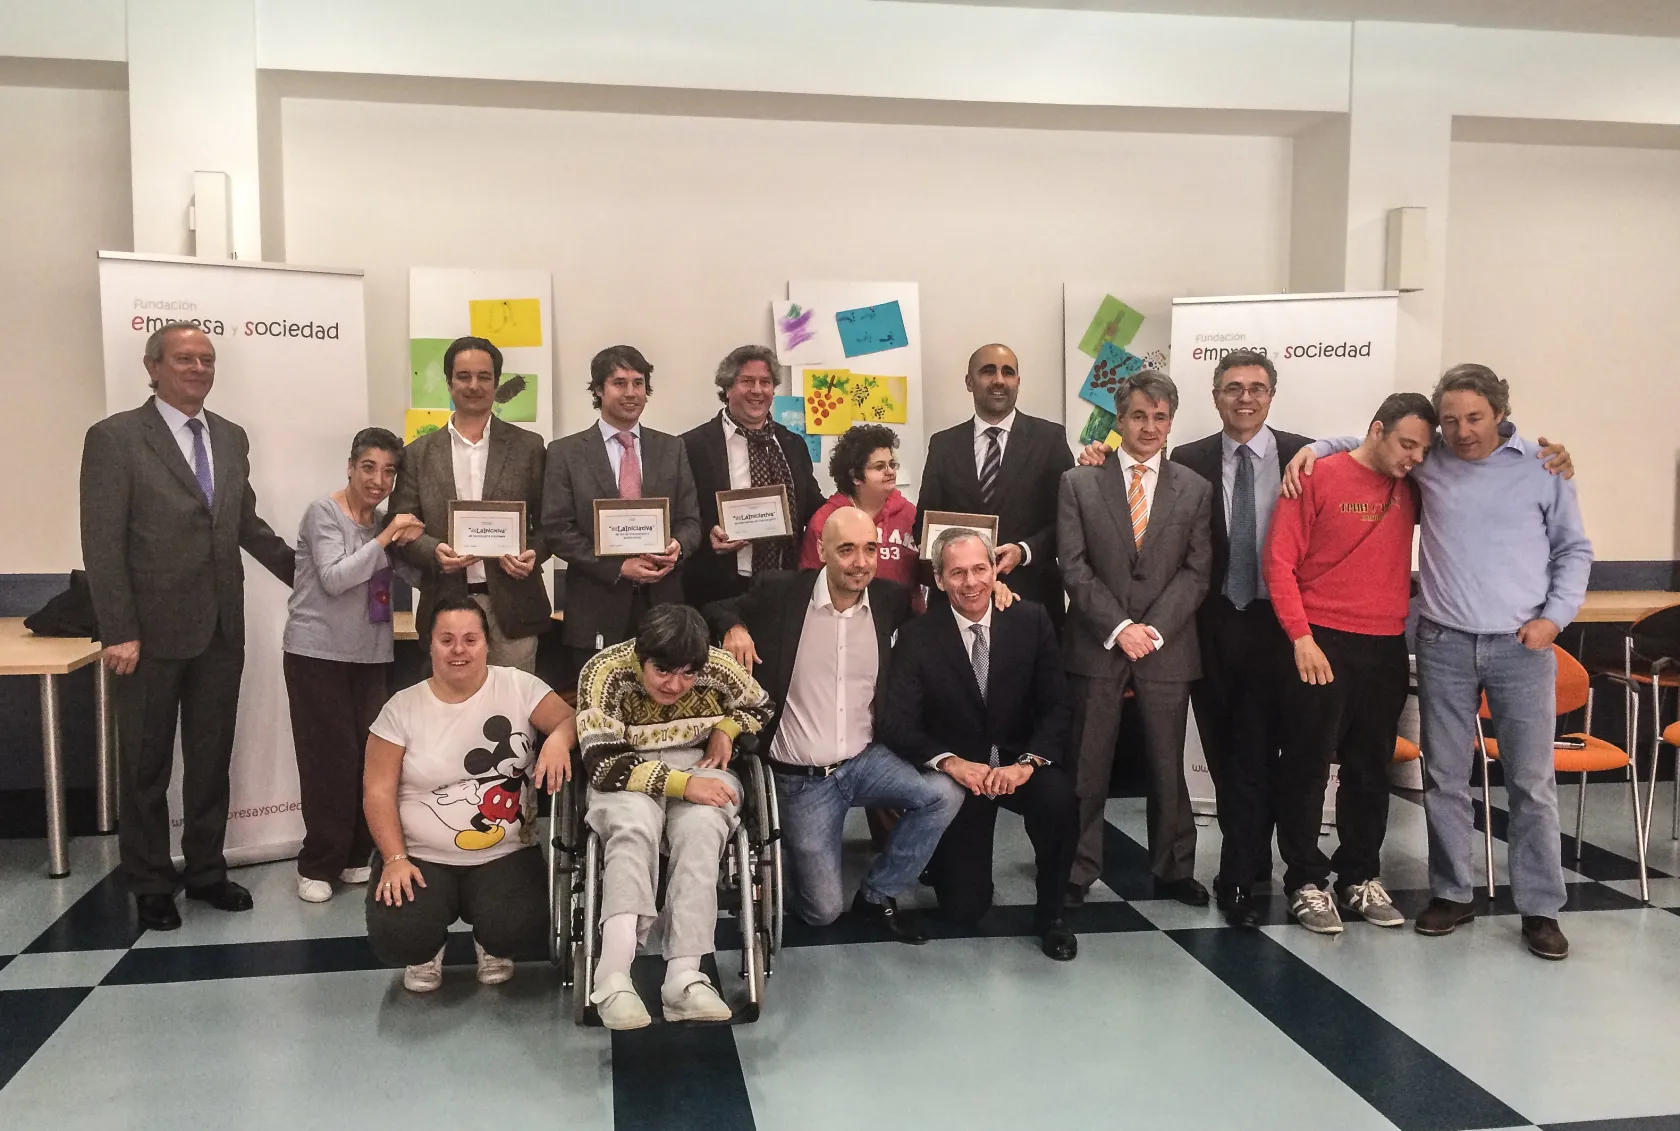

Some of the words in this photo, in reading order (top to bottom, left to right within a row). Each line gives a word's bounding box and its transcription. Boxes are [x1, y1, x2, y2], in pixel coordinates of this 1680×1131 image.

[131, 315, 224, 336] emesa
[231, 326, 238, 336] y
[244, 319, 340, 340] sociedad
[1284, 341, 1371, 359] sociedad
[880, 546, 901, 560] 93
